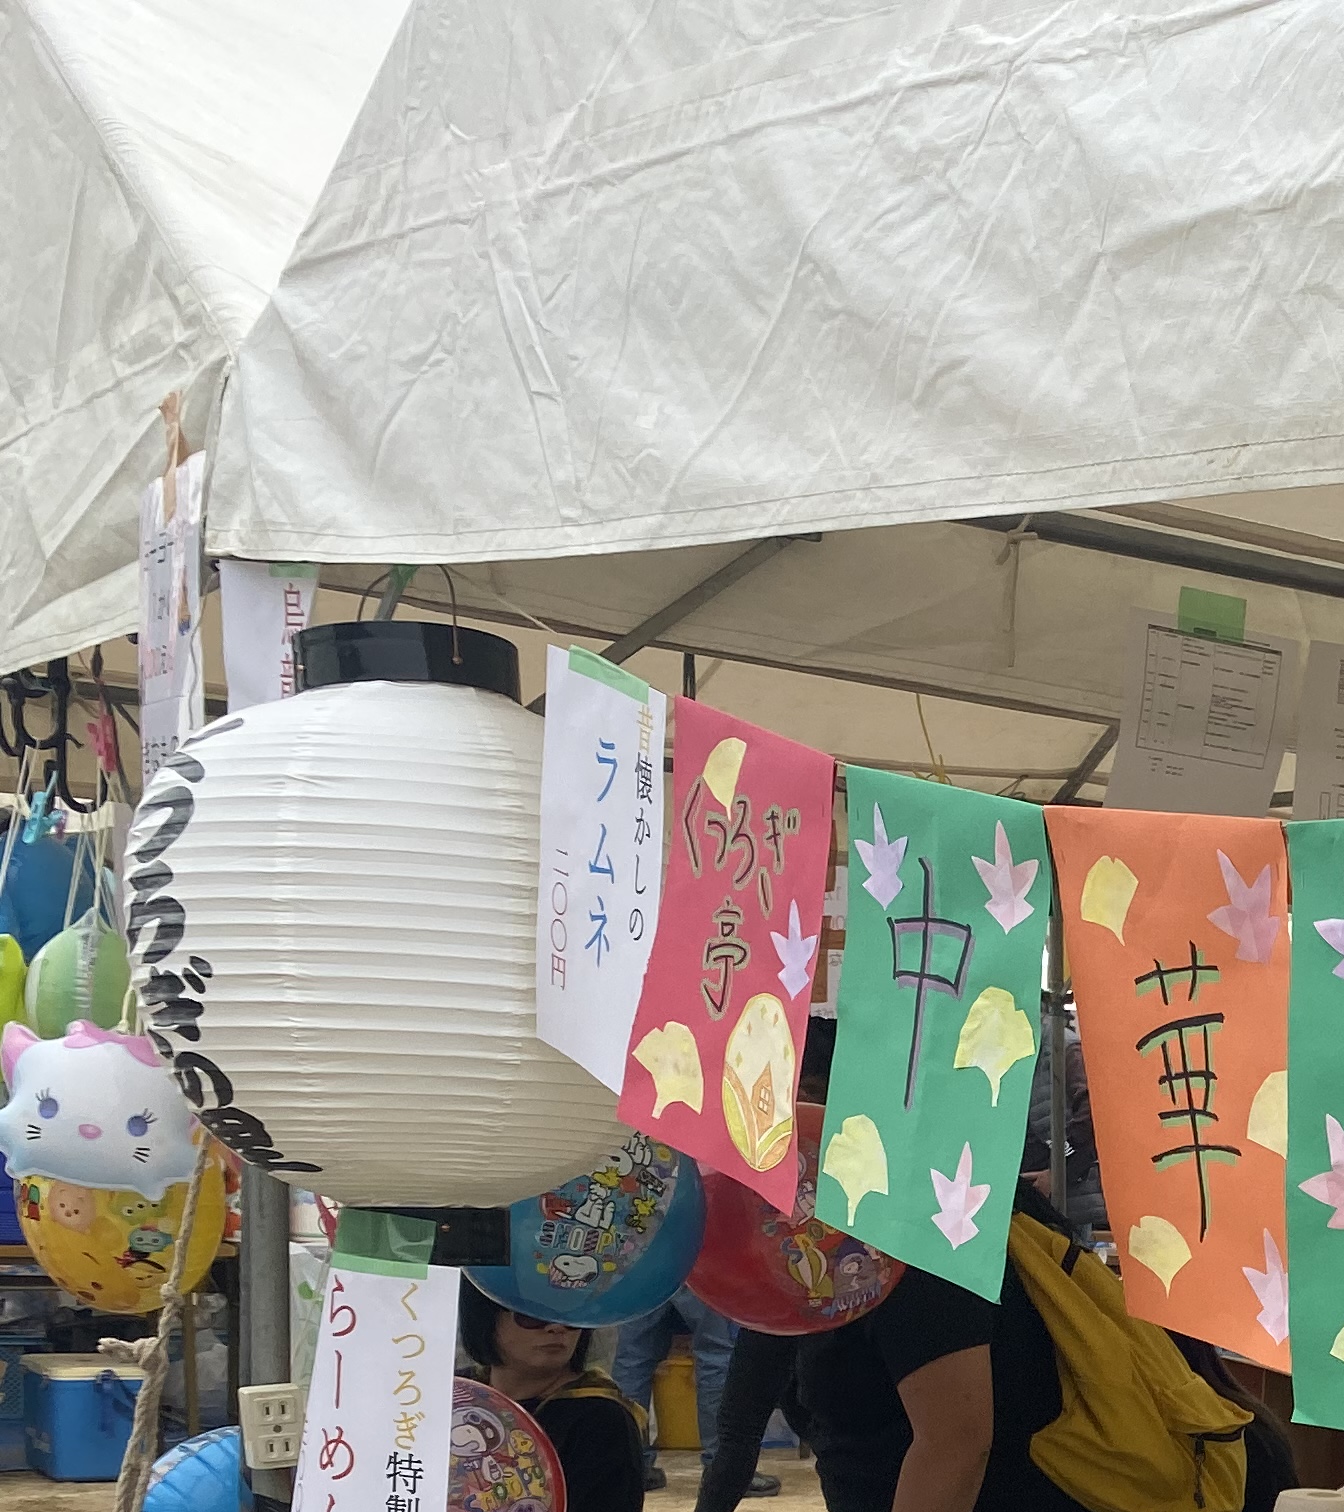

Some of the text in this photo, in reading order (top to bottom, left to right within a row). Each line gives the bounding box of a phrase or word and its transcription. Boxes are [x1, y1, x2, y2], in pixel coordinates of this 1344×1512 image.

[583, 737, 618, 969] ラムネ
[628, 705, 655, 944] 昔懐かしの
[701, 898, 749, 1015] 亭
[887, 857, 972, 1110] 中
[1134, 941, 1243, 1244] 華
